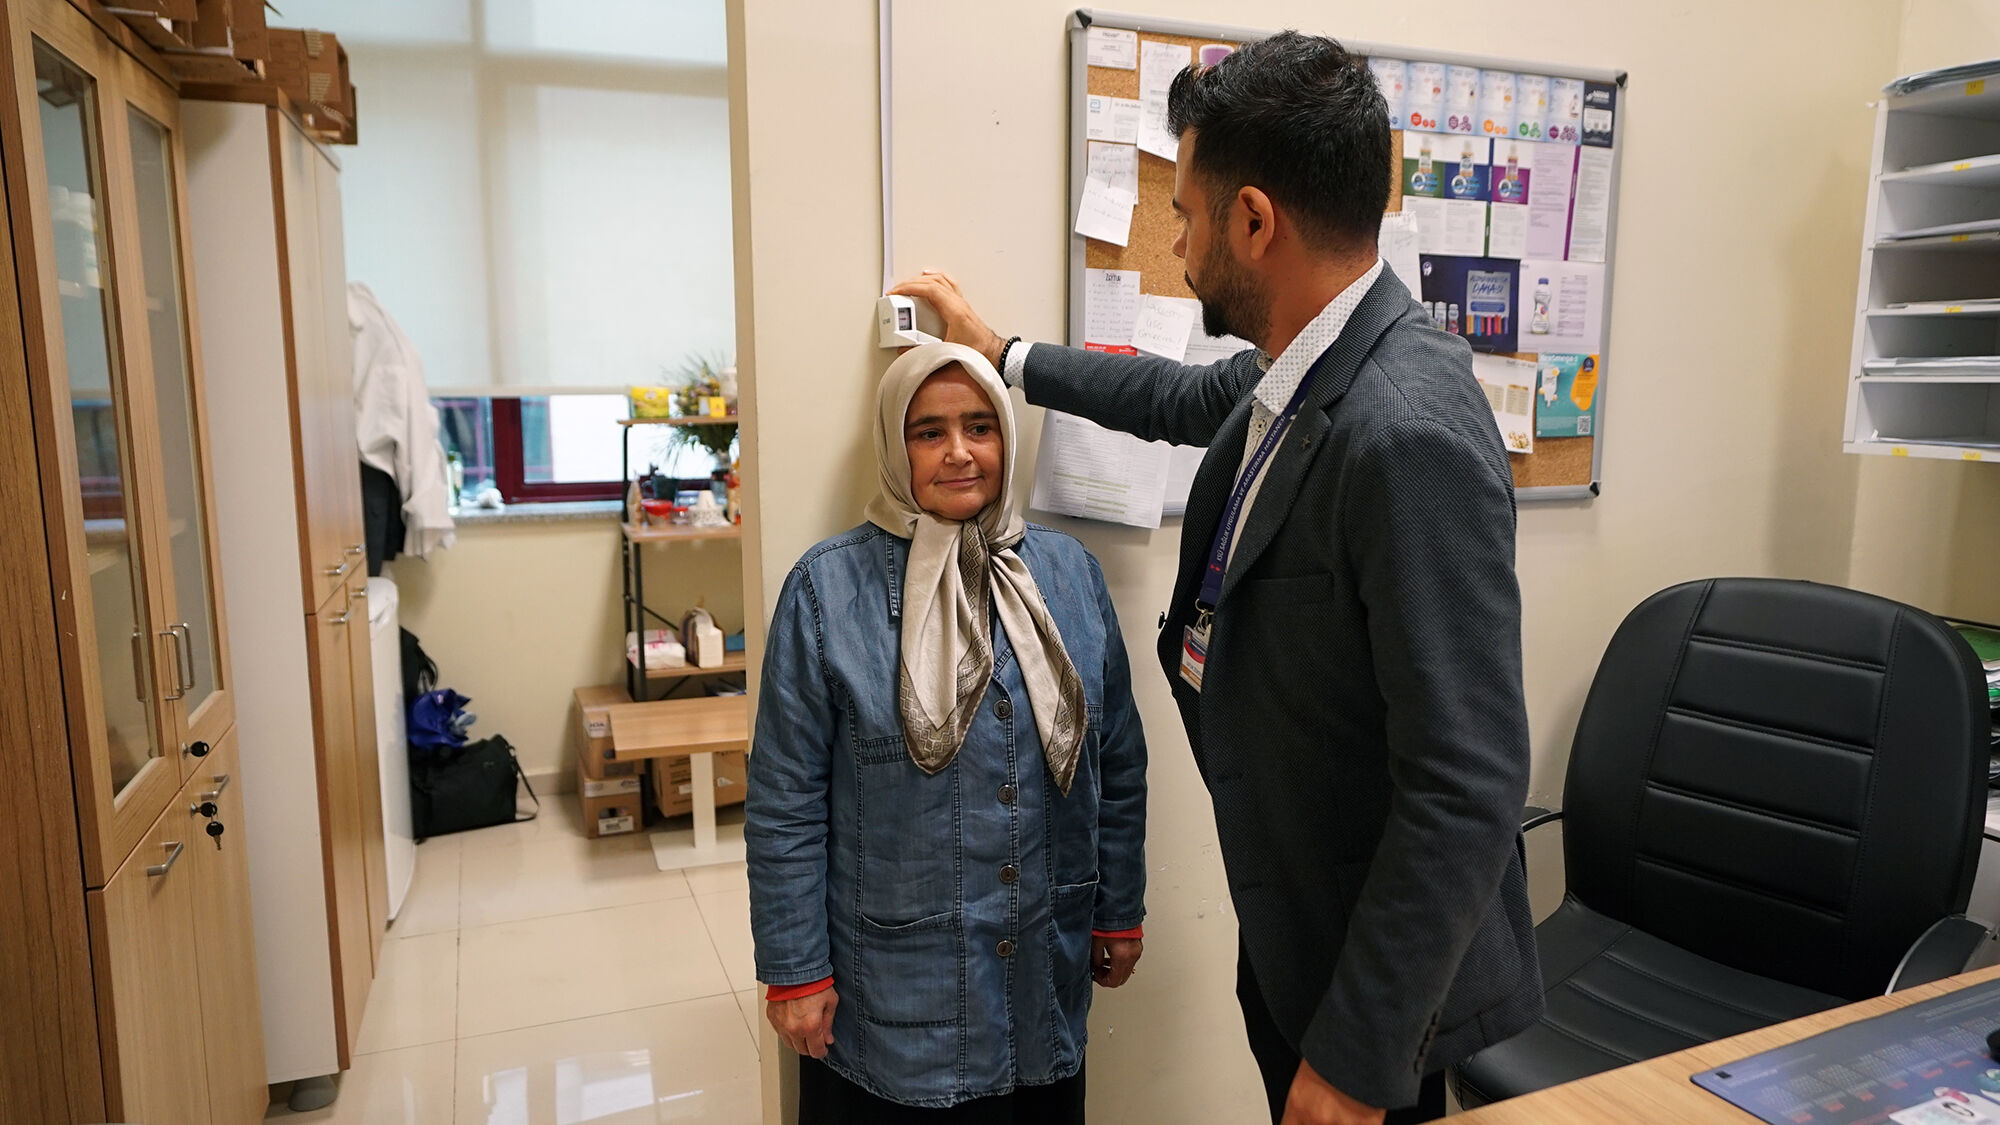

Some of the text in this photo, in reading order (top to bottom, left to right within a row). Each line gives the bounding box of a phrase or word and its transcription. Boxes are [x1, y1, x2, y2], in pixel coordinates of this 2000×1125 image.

[1220, 528, 1230, 551] SAĞLIK
[1226, 496, 1241, 531] UYGULAMA
[1238, 486, 1246, 498] VE
[1243, 450, 1266, 487] ARAŞTIRMA
